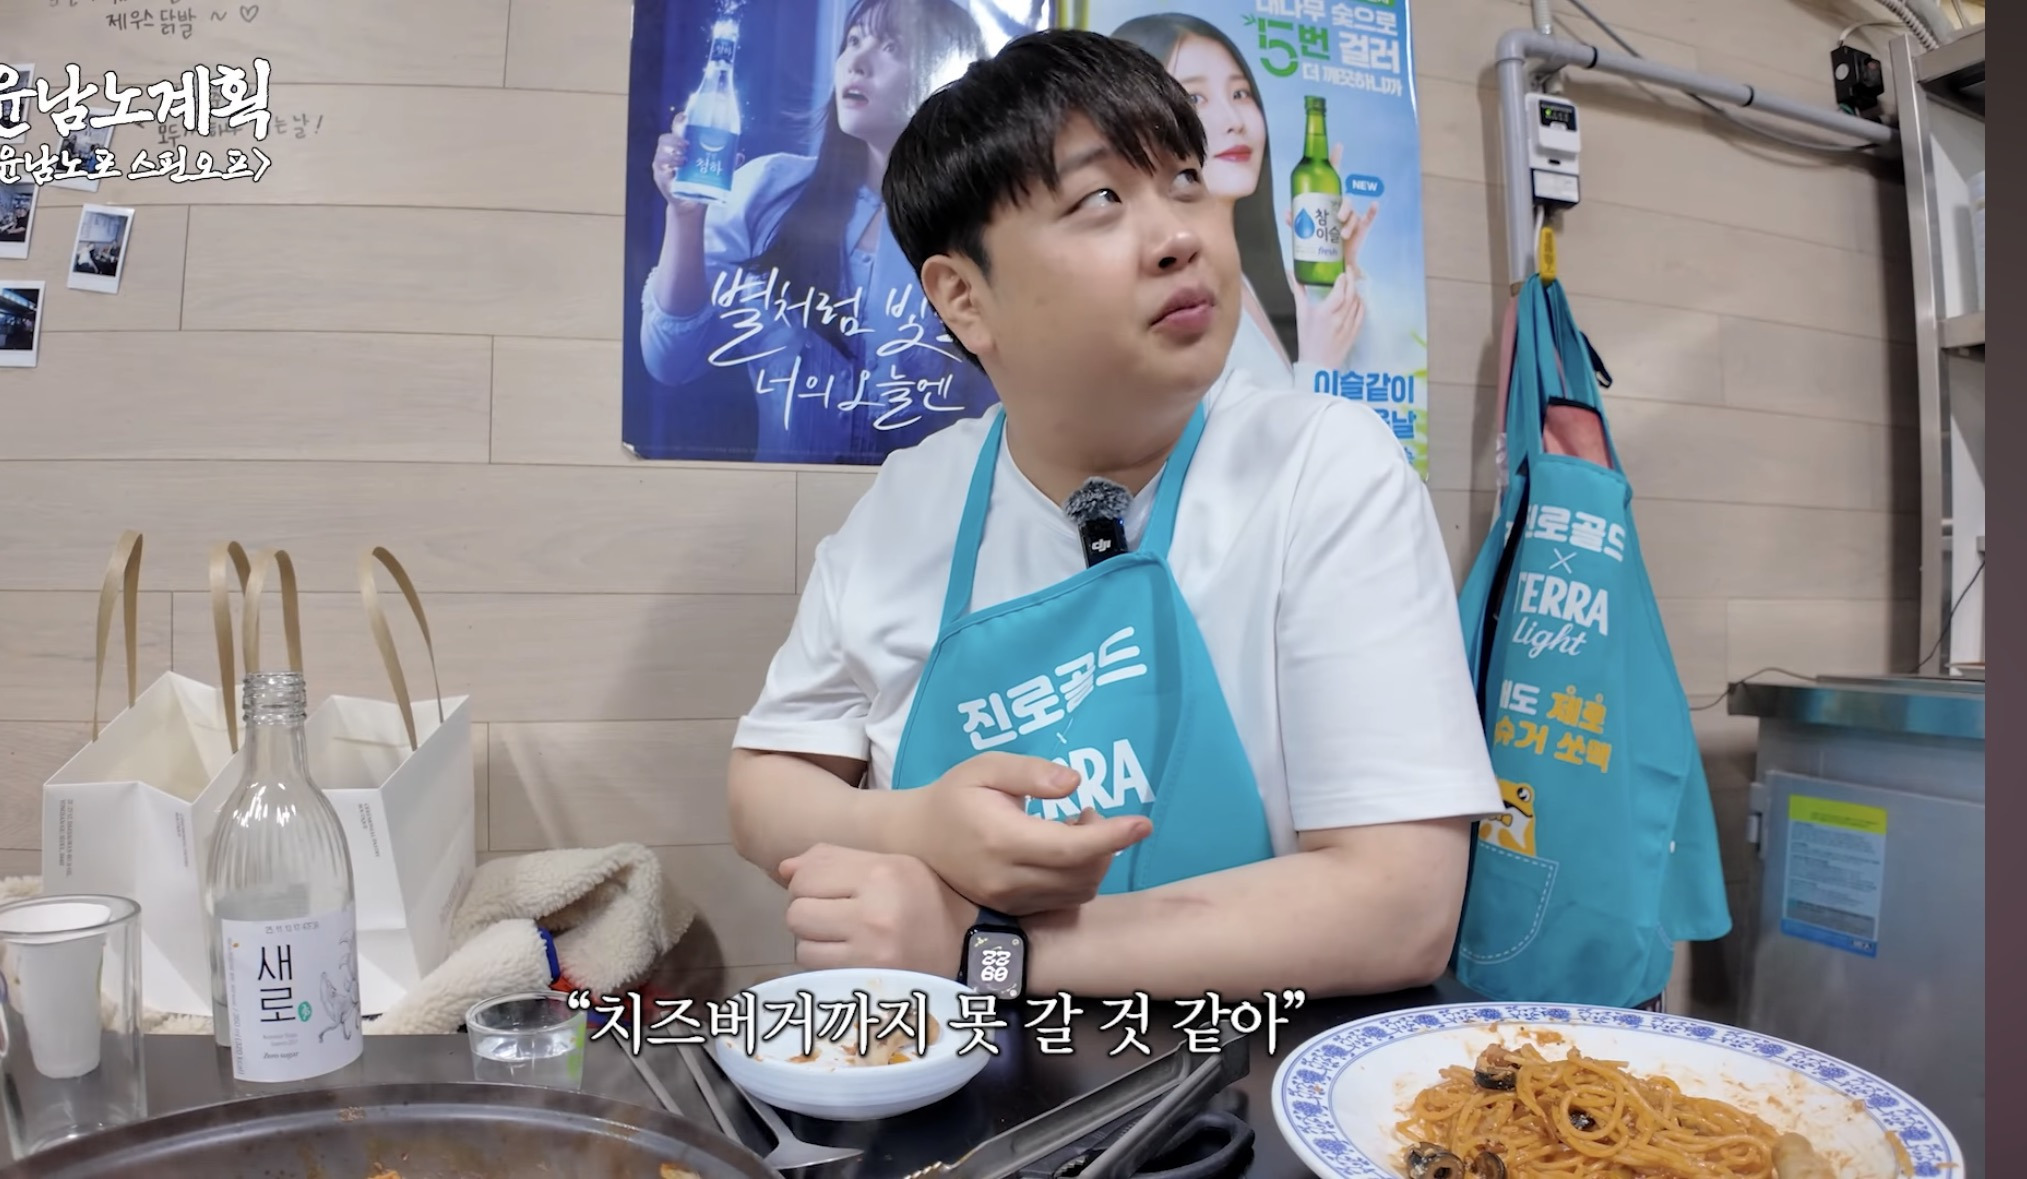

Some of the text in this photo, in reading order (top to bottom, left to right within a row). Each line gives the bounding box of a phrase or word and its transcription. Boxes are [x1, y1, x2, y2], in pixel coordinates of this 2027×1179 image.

[106, 9, 154, 31] 제우스
[160, 8, 197, 39] 닭발
[1331, 3, 1398, 37] 숯으로
[1339, 31, 1400, 74] 걸러
[1302, 63, 1403, 97] 더 깨끗하니까
[1352, 179, 1378, 191] NEW
[707, 267, 876, 367] 별처럼
[755, 356, 966, 431] 너의 오늘엔
[1314, 369, 1415, 404] 이슬같이
[1512, 616, 1587, 659] Light
[957, 626, 1147, 750] 진로골드
[258, 944, 296, 1022] 새로
